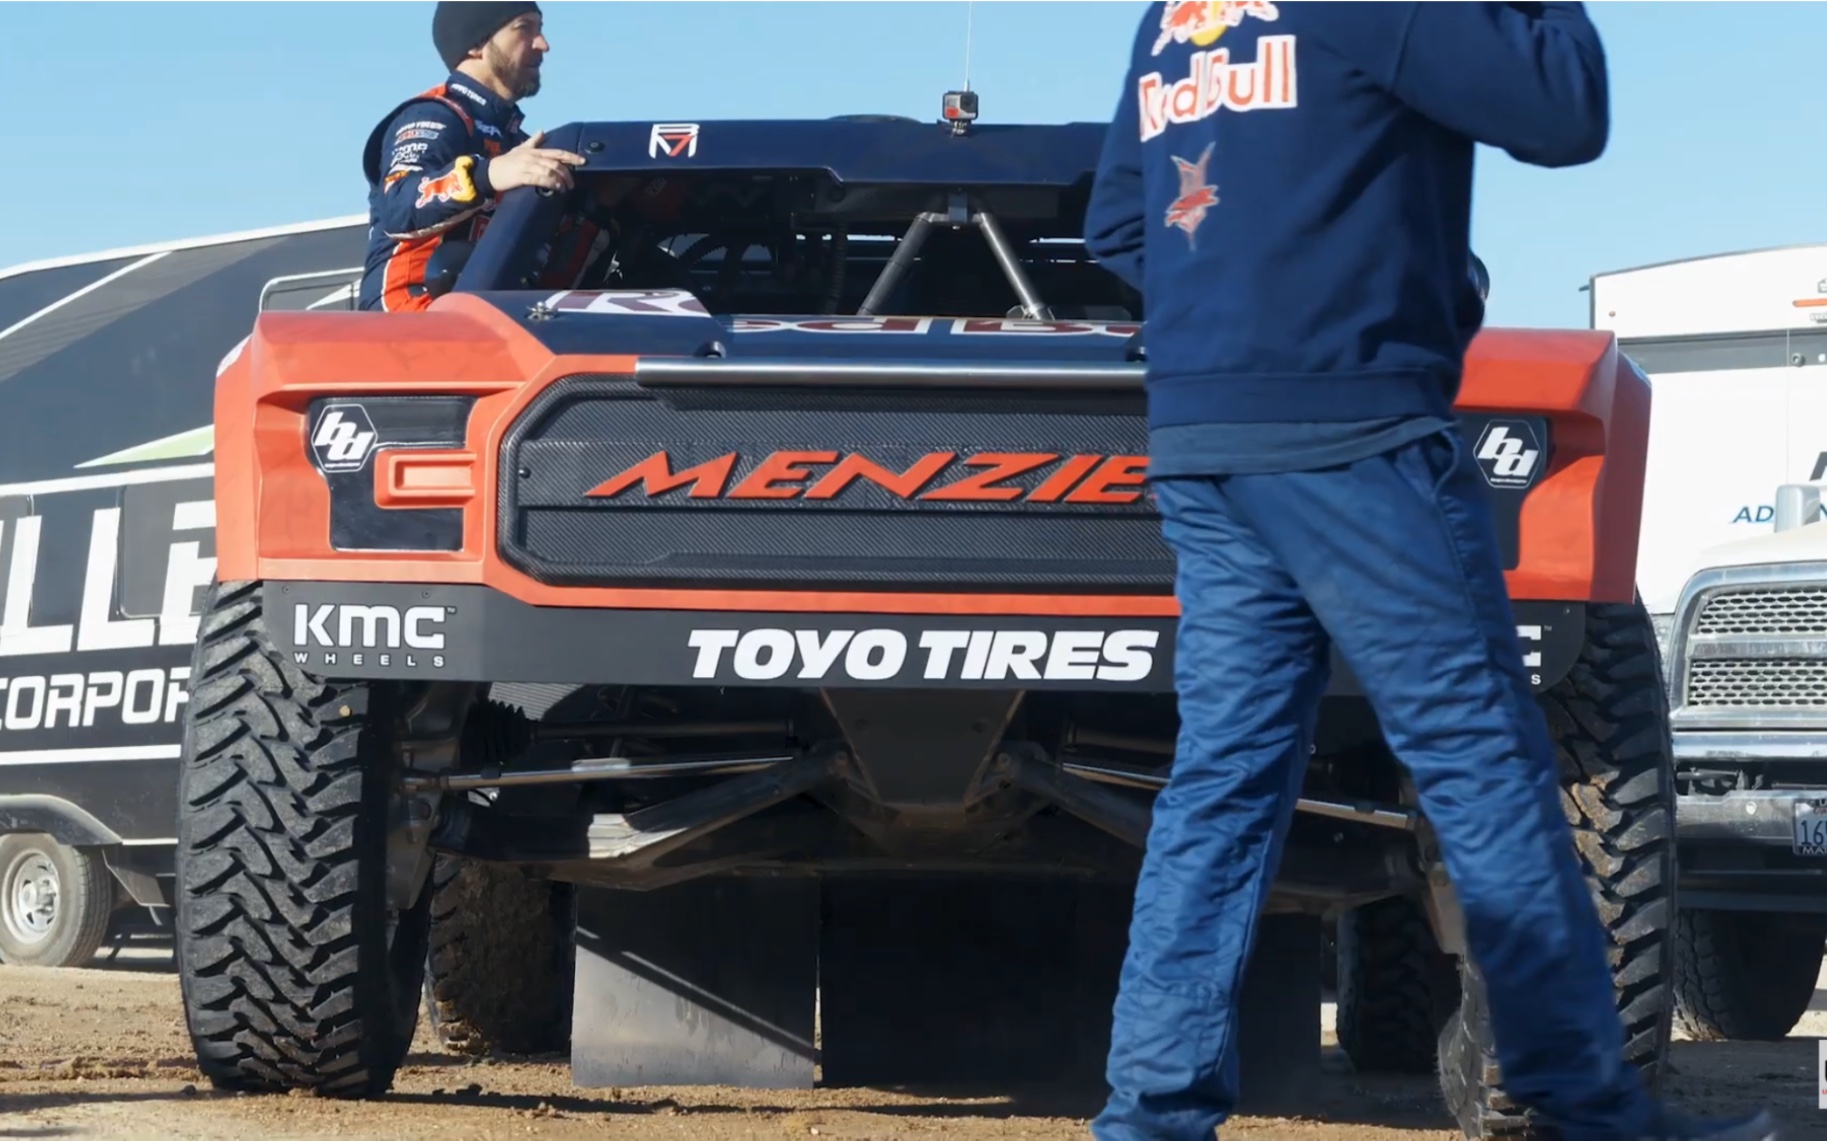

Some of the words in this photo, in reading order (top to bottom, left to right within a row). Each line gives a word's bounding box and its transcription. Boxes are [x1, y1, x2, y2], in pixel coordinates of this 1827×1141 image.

[1139, 52, 1202, 142] Rd
[584, 450, 1152, 503] MENZIE
[294, 653, 445, 668] WHEELS
[687, 628, 908, 681] TOYO
[918, 629, 1160, 682] TIRES
